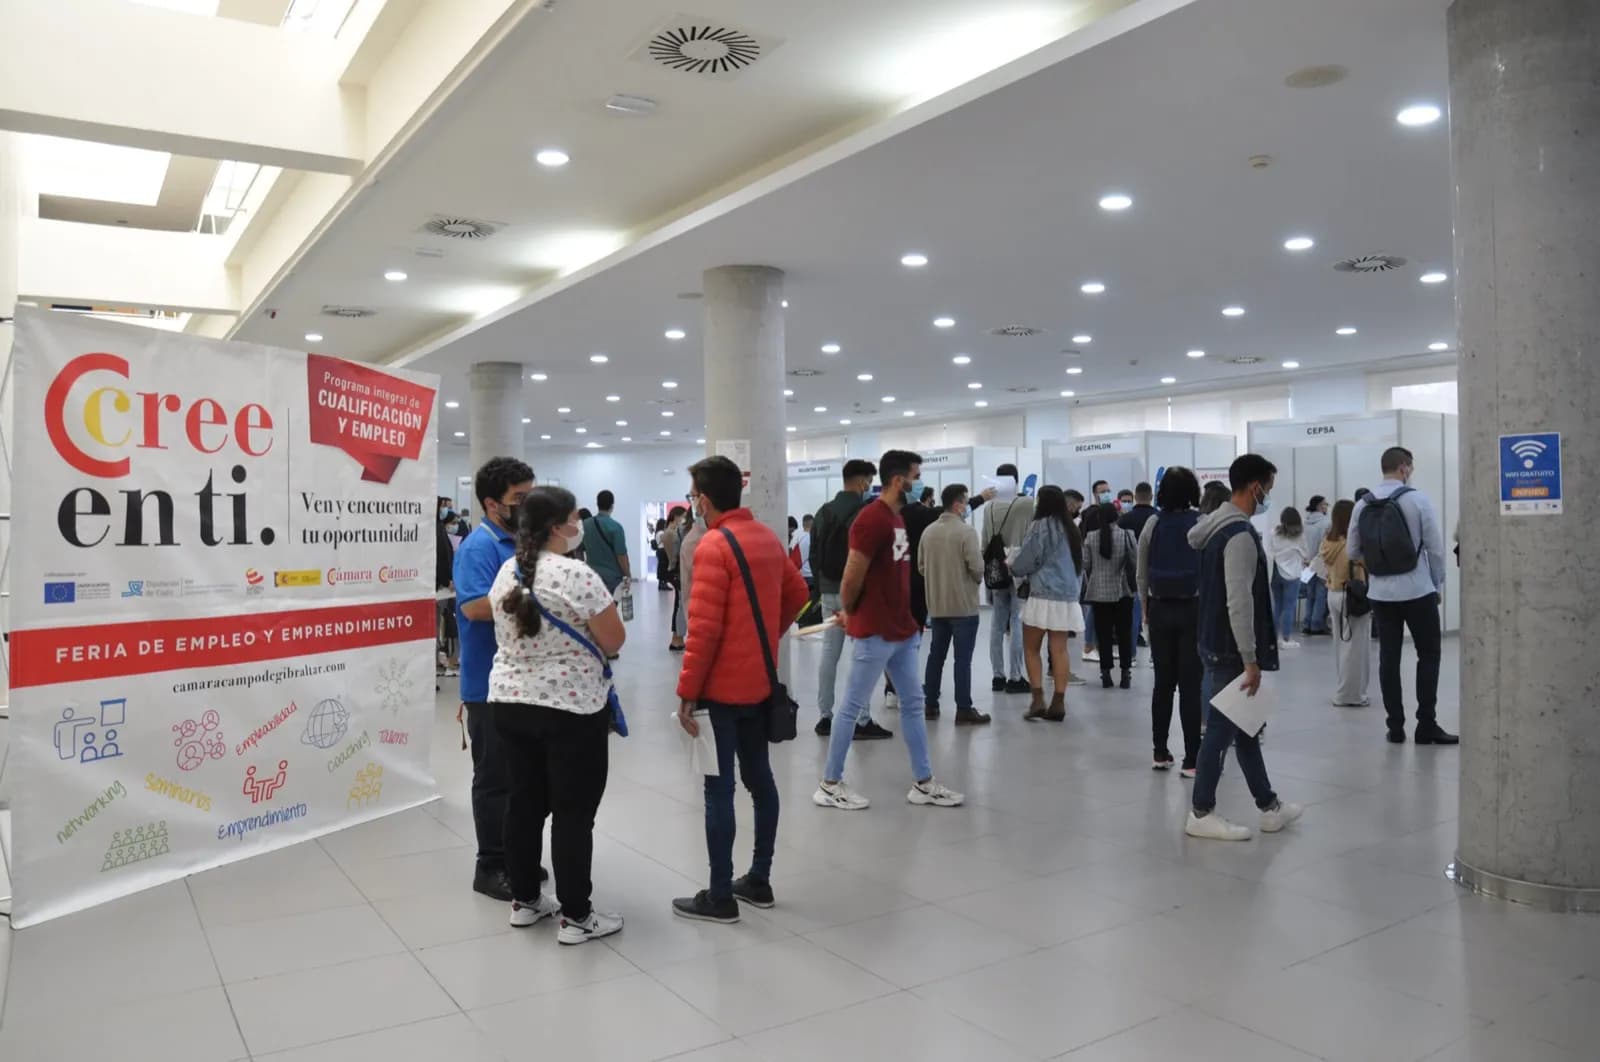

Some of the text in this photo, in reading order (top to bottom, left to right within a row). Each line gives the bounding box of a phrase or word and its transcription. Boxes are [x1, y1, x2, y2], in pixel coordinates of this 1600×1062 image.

[323, 371, 420, 409] Programa integral de
[317, 388, 422, 430] CUALIFICACIÓN
[338, 416, 406, 448] Y EMPLEO
[1075, 442, 1112, 453] DECATHLON
[1306, 425, 1335, 435] CEPSA
[57, 464, 275, 548] en ti.
[301, 491, 422, 520] Ven y encuentra
[302, 523, 419, 550] tu oportunidad
[55, 615, 414, 664] FERIA DE EMPLEO Y EMPRENDIMIENTO
[172, 661, 347, 694] camaracampodegibraltar.com
[56, 779, 128, 845] networking
[217, 802, 308, 842] Emprendimiento
